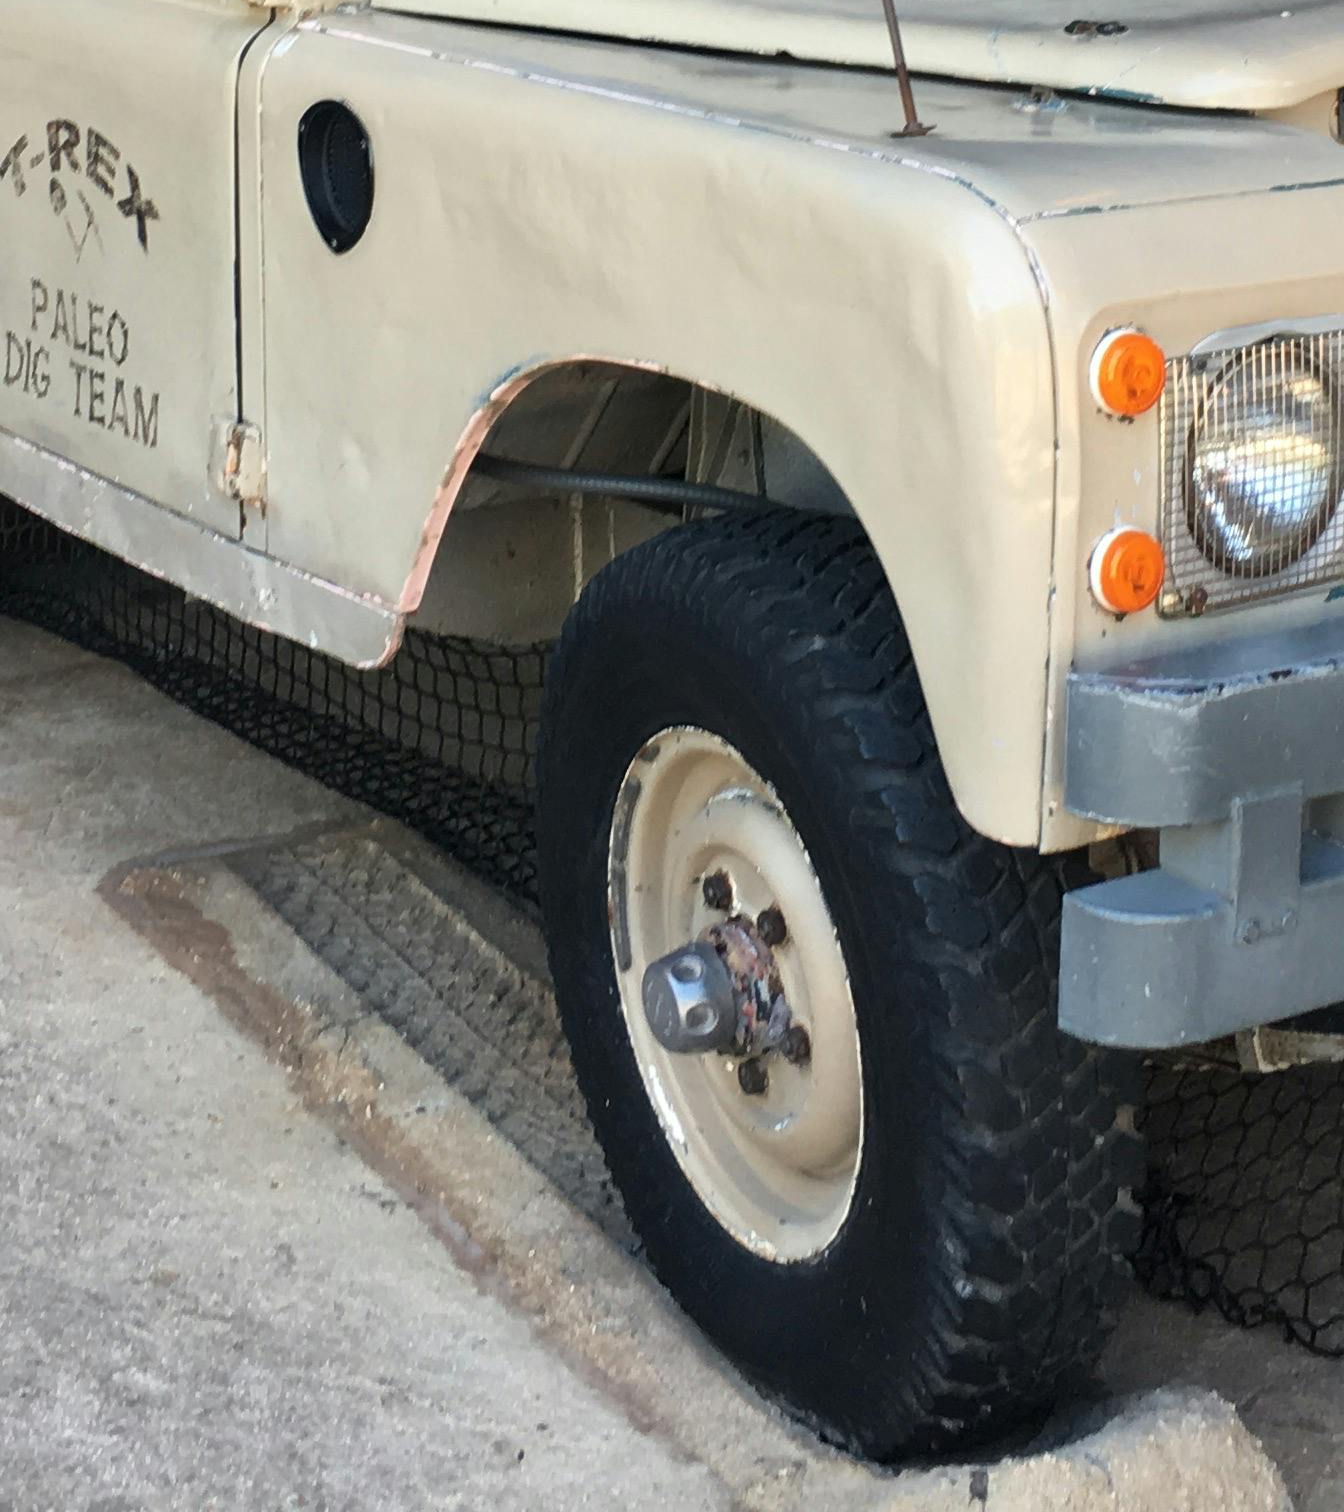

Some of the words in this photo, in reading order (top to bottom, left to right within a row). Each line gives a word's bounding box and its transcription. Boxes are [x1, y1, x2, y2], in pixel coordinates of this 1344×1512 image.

[29, 276, 130, 366] PALEO
[2, 329, 52, 399] DIG
[69, 359, 161, 449] TEAM
